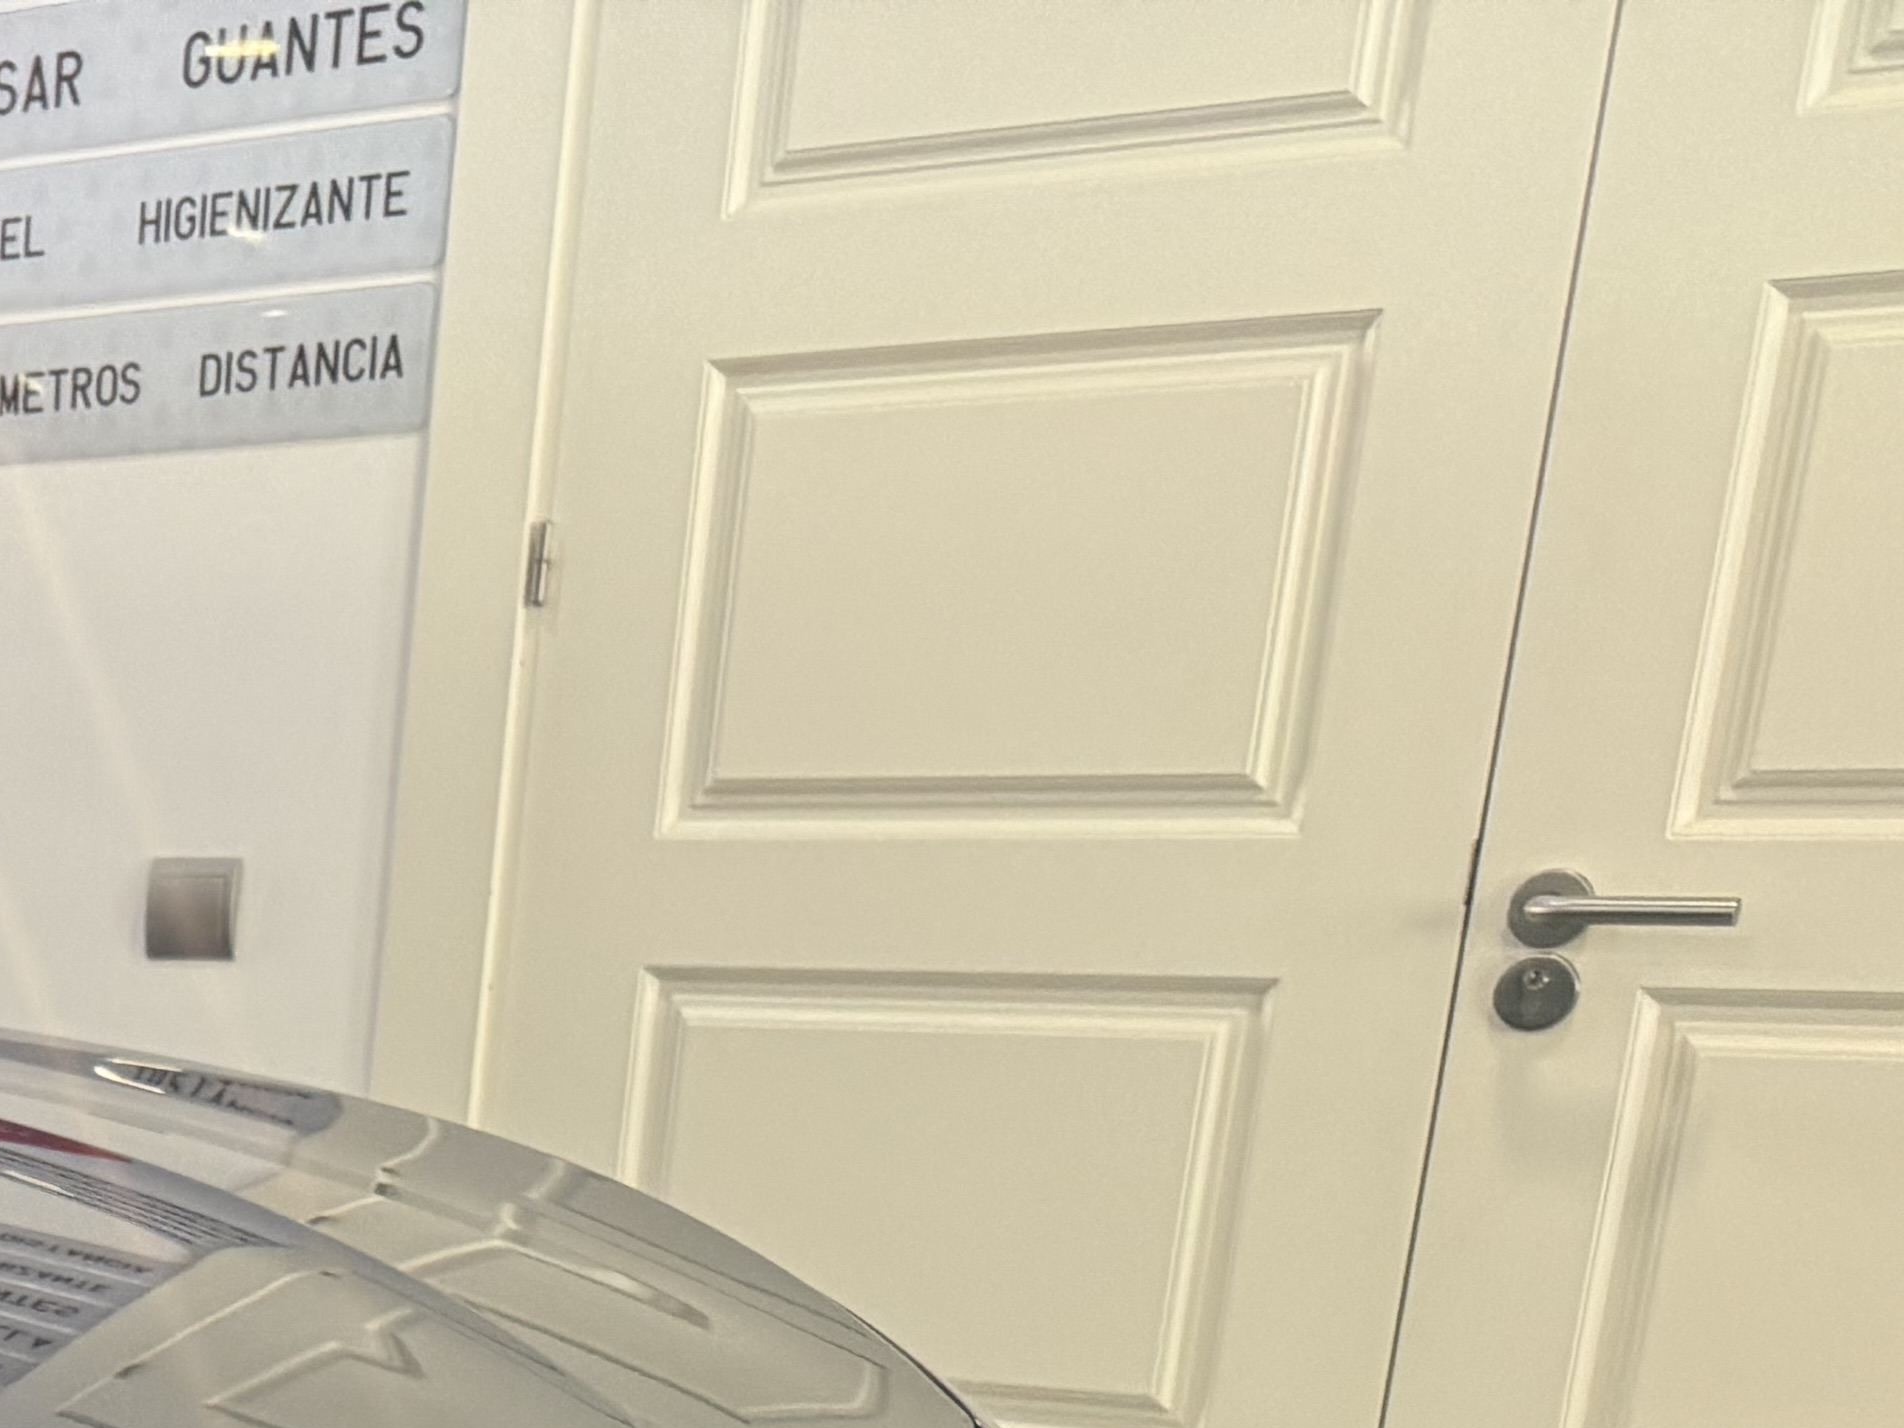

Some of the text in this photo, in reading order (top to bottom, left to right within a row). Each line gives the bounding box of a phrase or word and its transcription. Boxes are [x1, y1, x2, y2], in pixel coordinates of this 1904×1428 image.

[182, 0, 425, 89] GUANTES
[138, 171, 411, 245] HIGIENIZANTE
[198, 334, 404, 397] DISTANCIA
